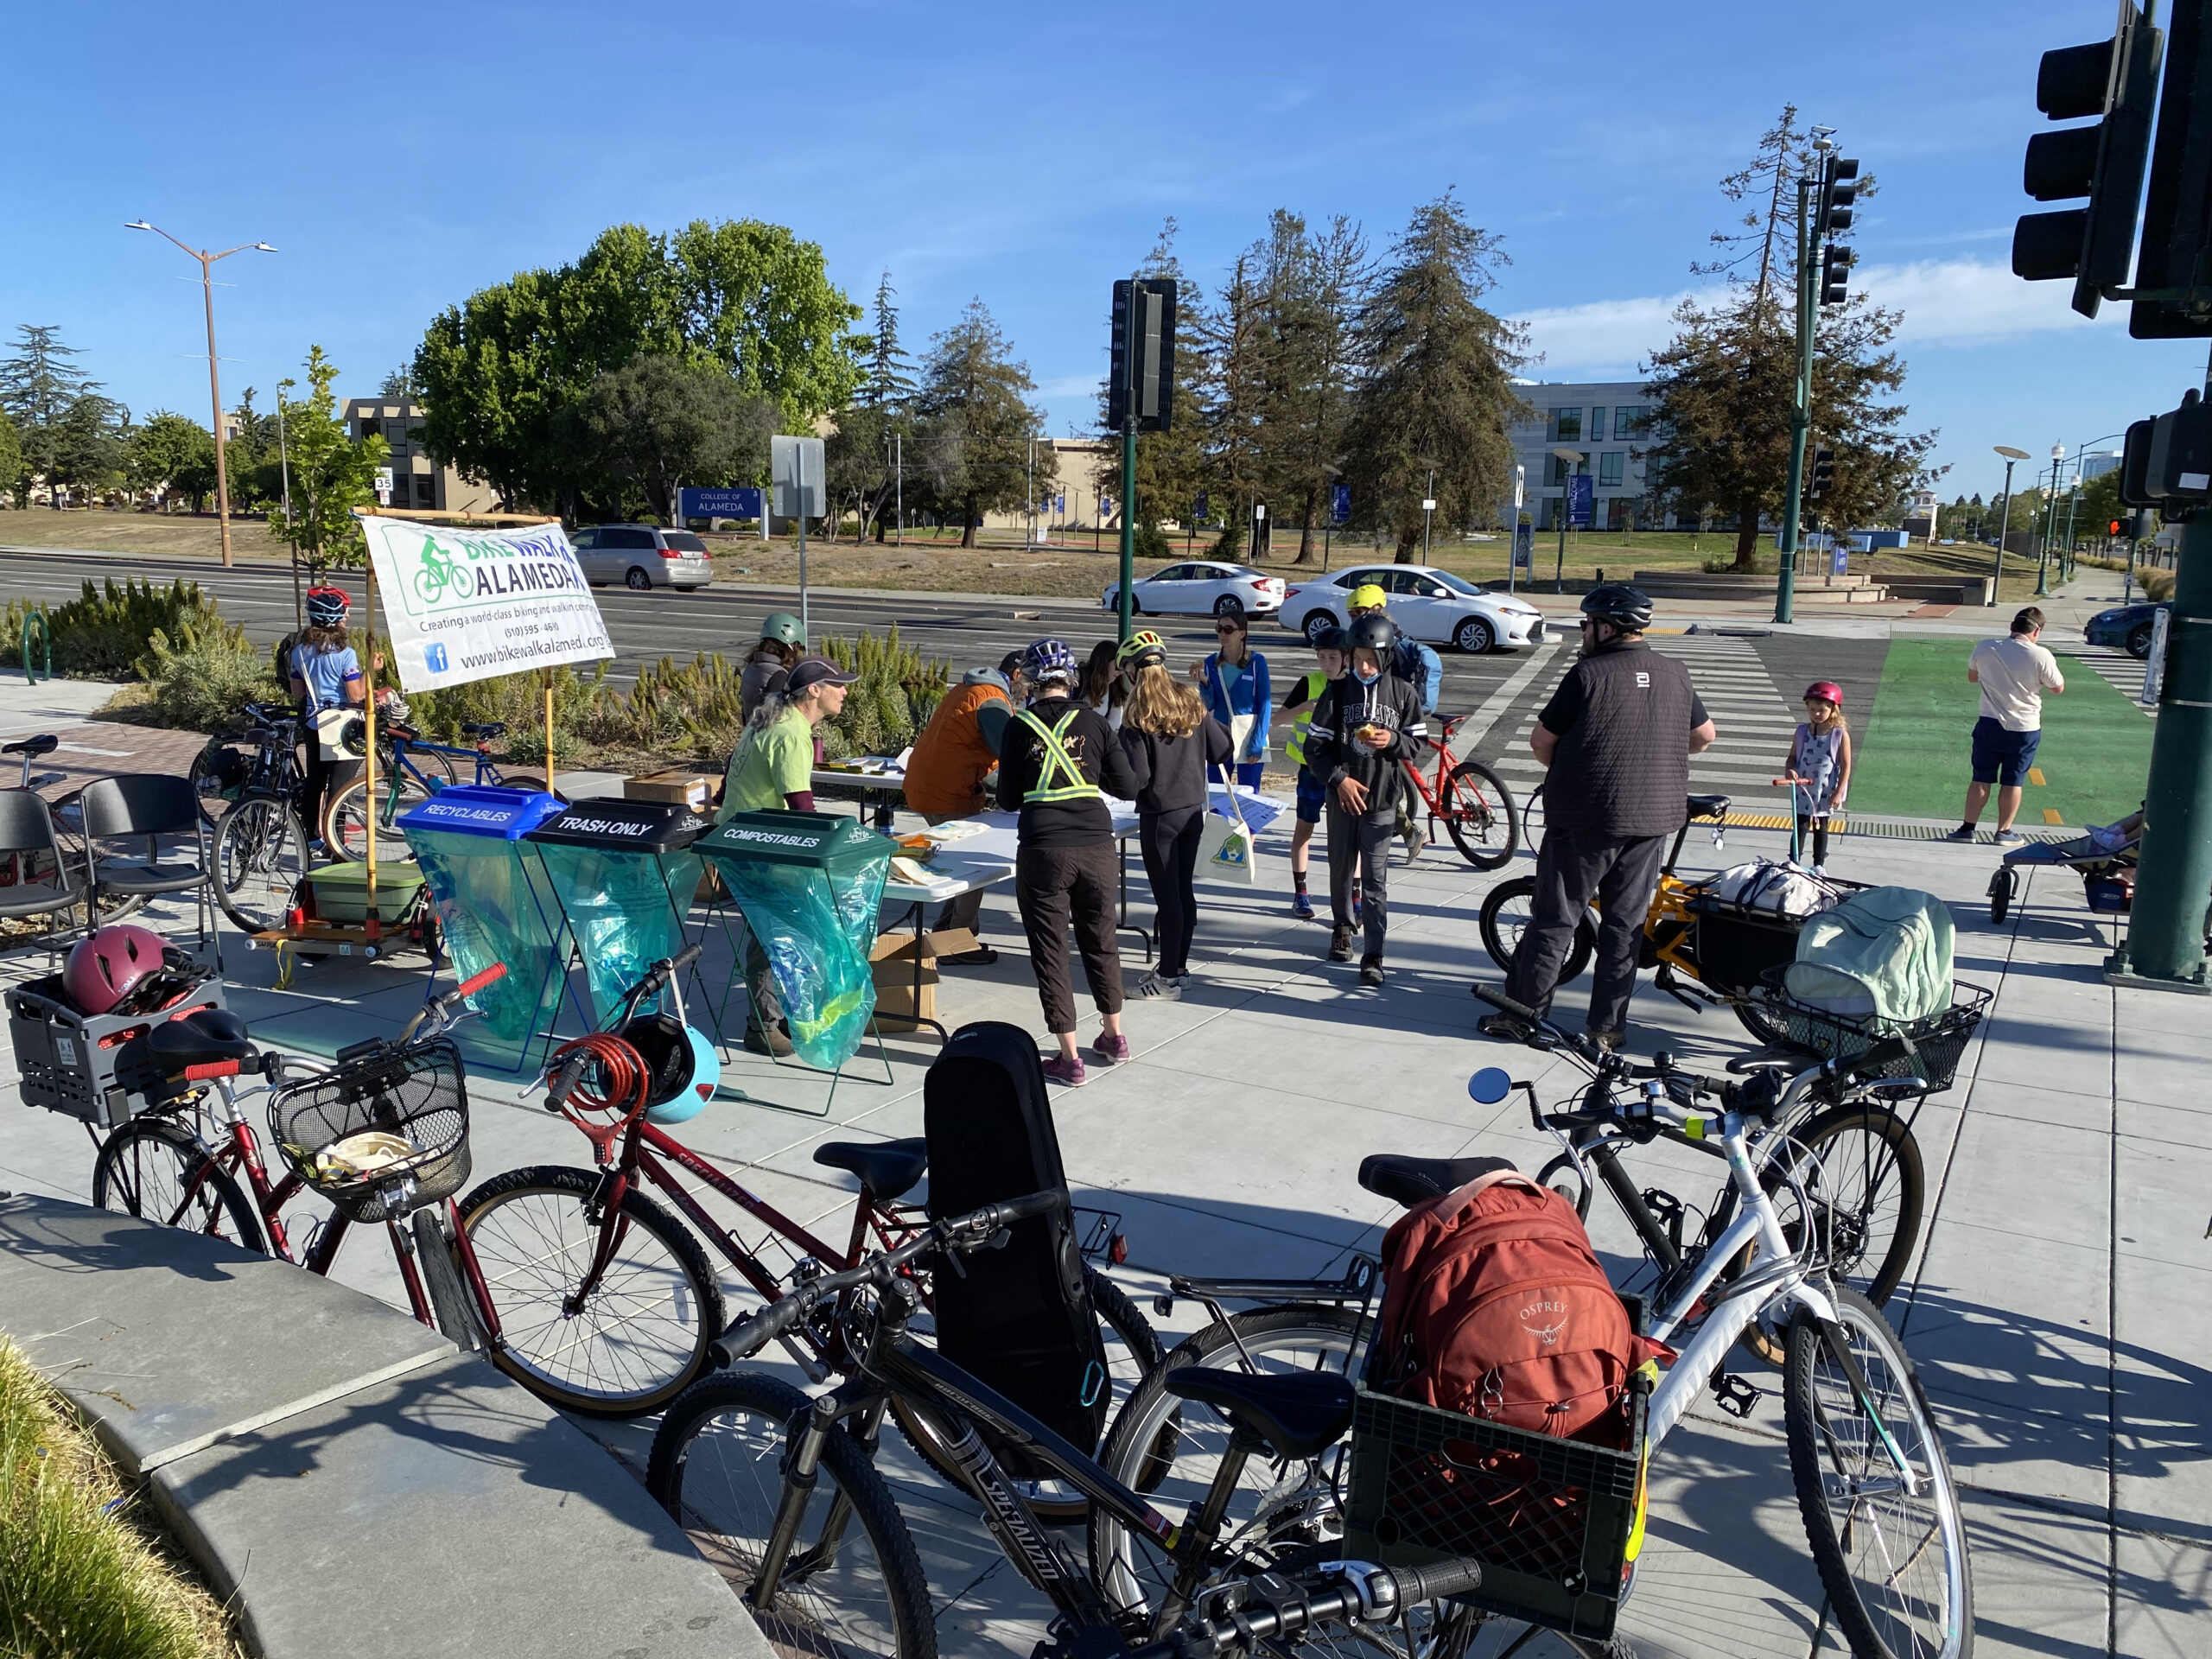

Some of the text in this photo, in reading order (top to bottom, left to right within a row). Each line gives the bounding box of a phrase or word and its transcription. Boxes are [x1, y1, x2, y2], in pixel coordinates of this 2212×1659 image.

[377, 480, 391, 488] 35
[1570, 476, 1579, 512] WELCOME
[698, 502, 744, 512] ALAMEDA
[454, 535, 561, 561] BIKE WALK
[476, 563, 577, 596] ALAMEDA
[420, 616, 464, 632] Creating
[464, 616, 470, 625] a
[470, 608, 512, 624] world-class
[514, 606, 538, 619] bking
[538, 605, 550, 614] and
[551, 603, 575, 613] walkin
[505, 625, 524, 639] (510)
[524, 624, 539, 635] 595
[461, 633, 605, 669] www.bikewalkalamed.org
[423, 804, 512, 822] RECYCLABLES
[558, 817, 654, 836] TRASH ONLY
[723, 829, 820, 848] COMPOSTABLES
[678, 1152, 754, 1210] SPECIALIZED
[1520, 1301, 1567, 1320] OSPREY
[986, 1481, 1059, 1580] SPECIALIZED
